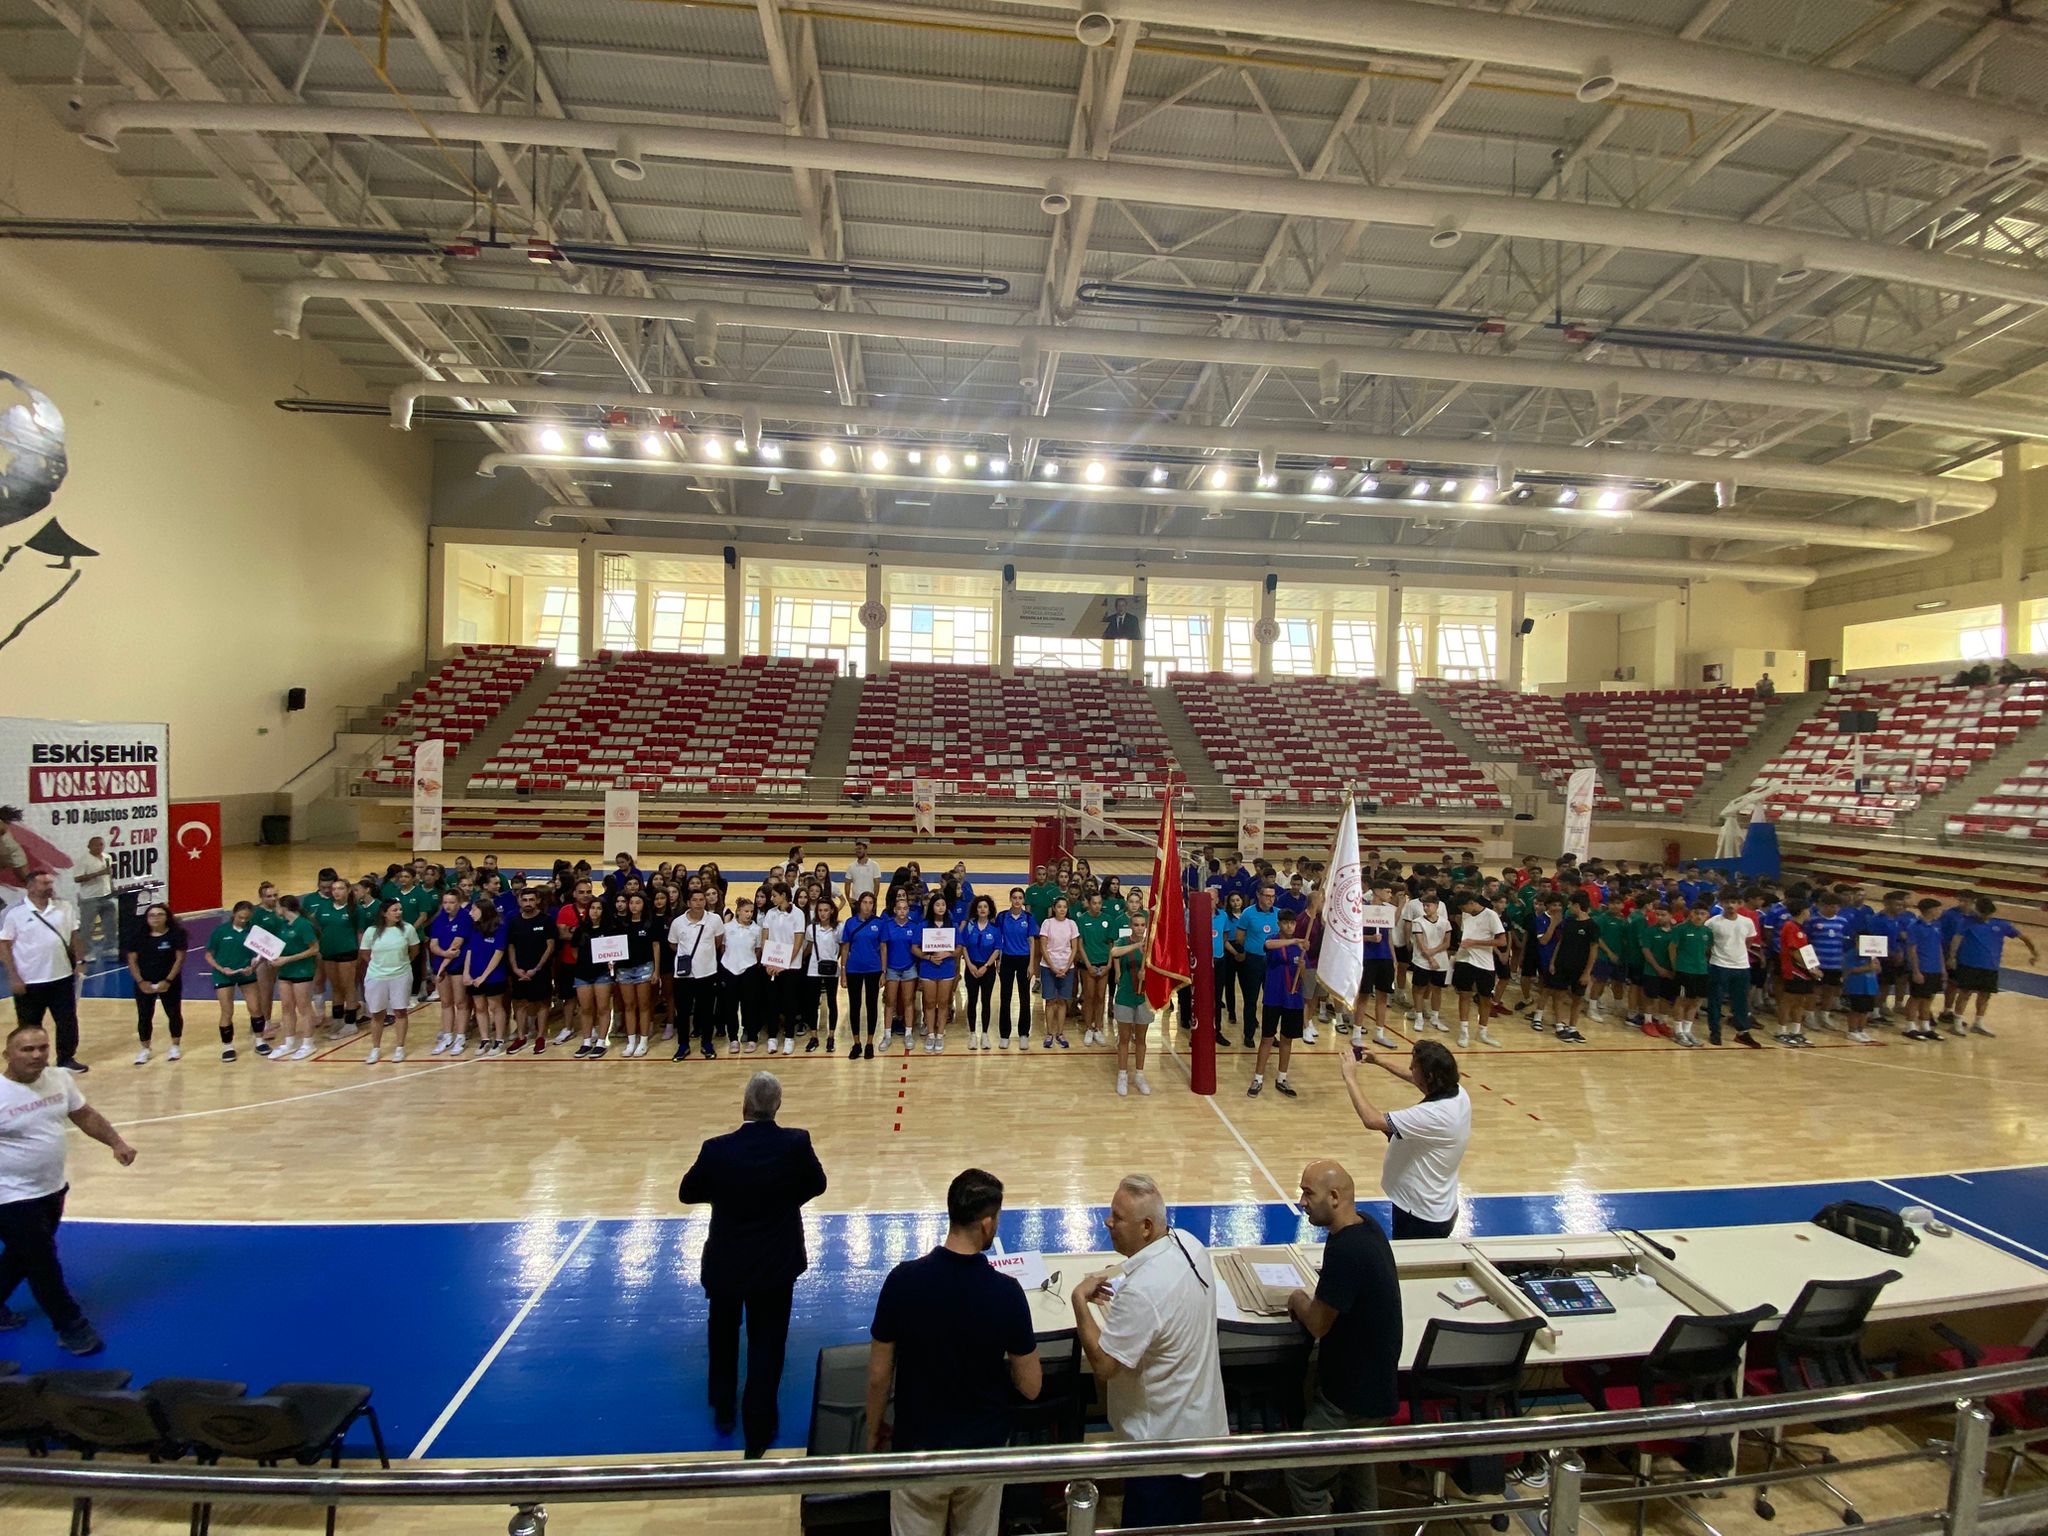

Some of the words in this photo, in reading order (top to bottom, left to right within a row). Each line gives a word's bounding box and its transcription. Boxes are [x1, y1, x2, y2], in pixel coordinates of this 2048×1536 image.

[32, 740, 158, 766] ESKİŞEHİR
[39, 770, 151, 798] VOLEYBOL
[51, 808, 80, 826] 8-10
[82, 807, 129, 824] Ağustos
[131, 804, 158, 820] 2025
[109, 825, 125, 847] 2.
[130, 827, 158, 846] ETAP
